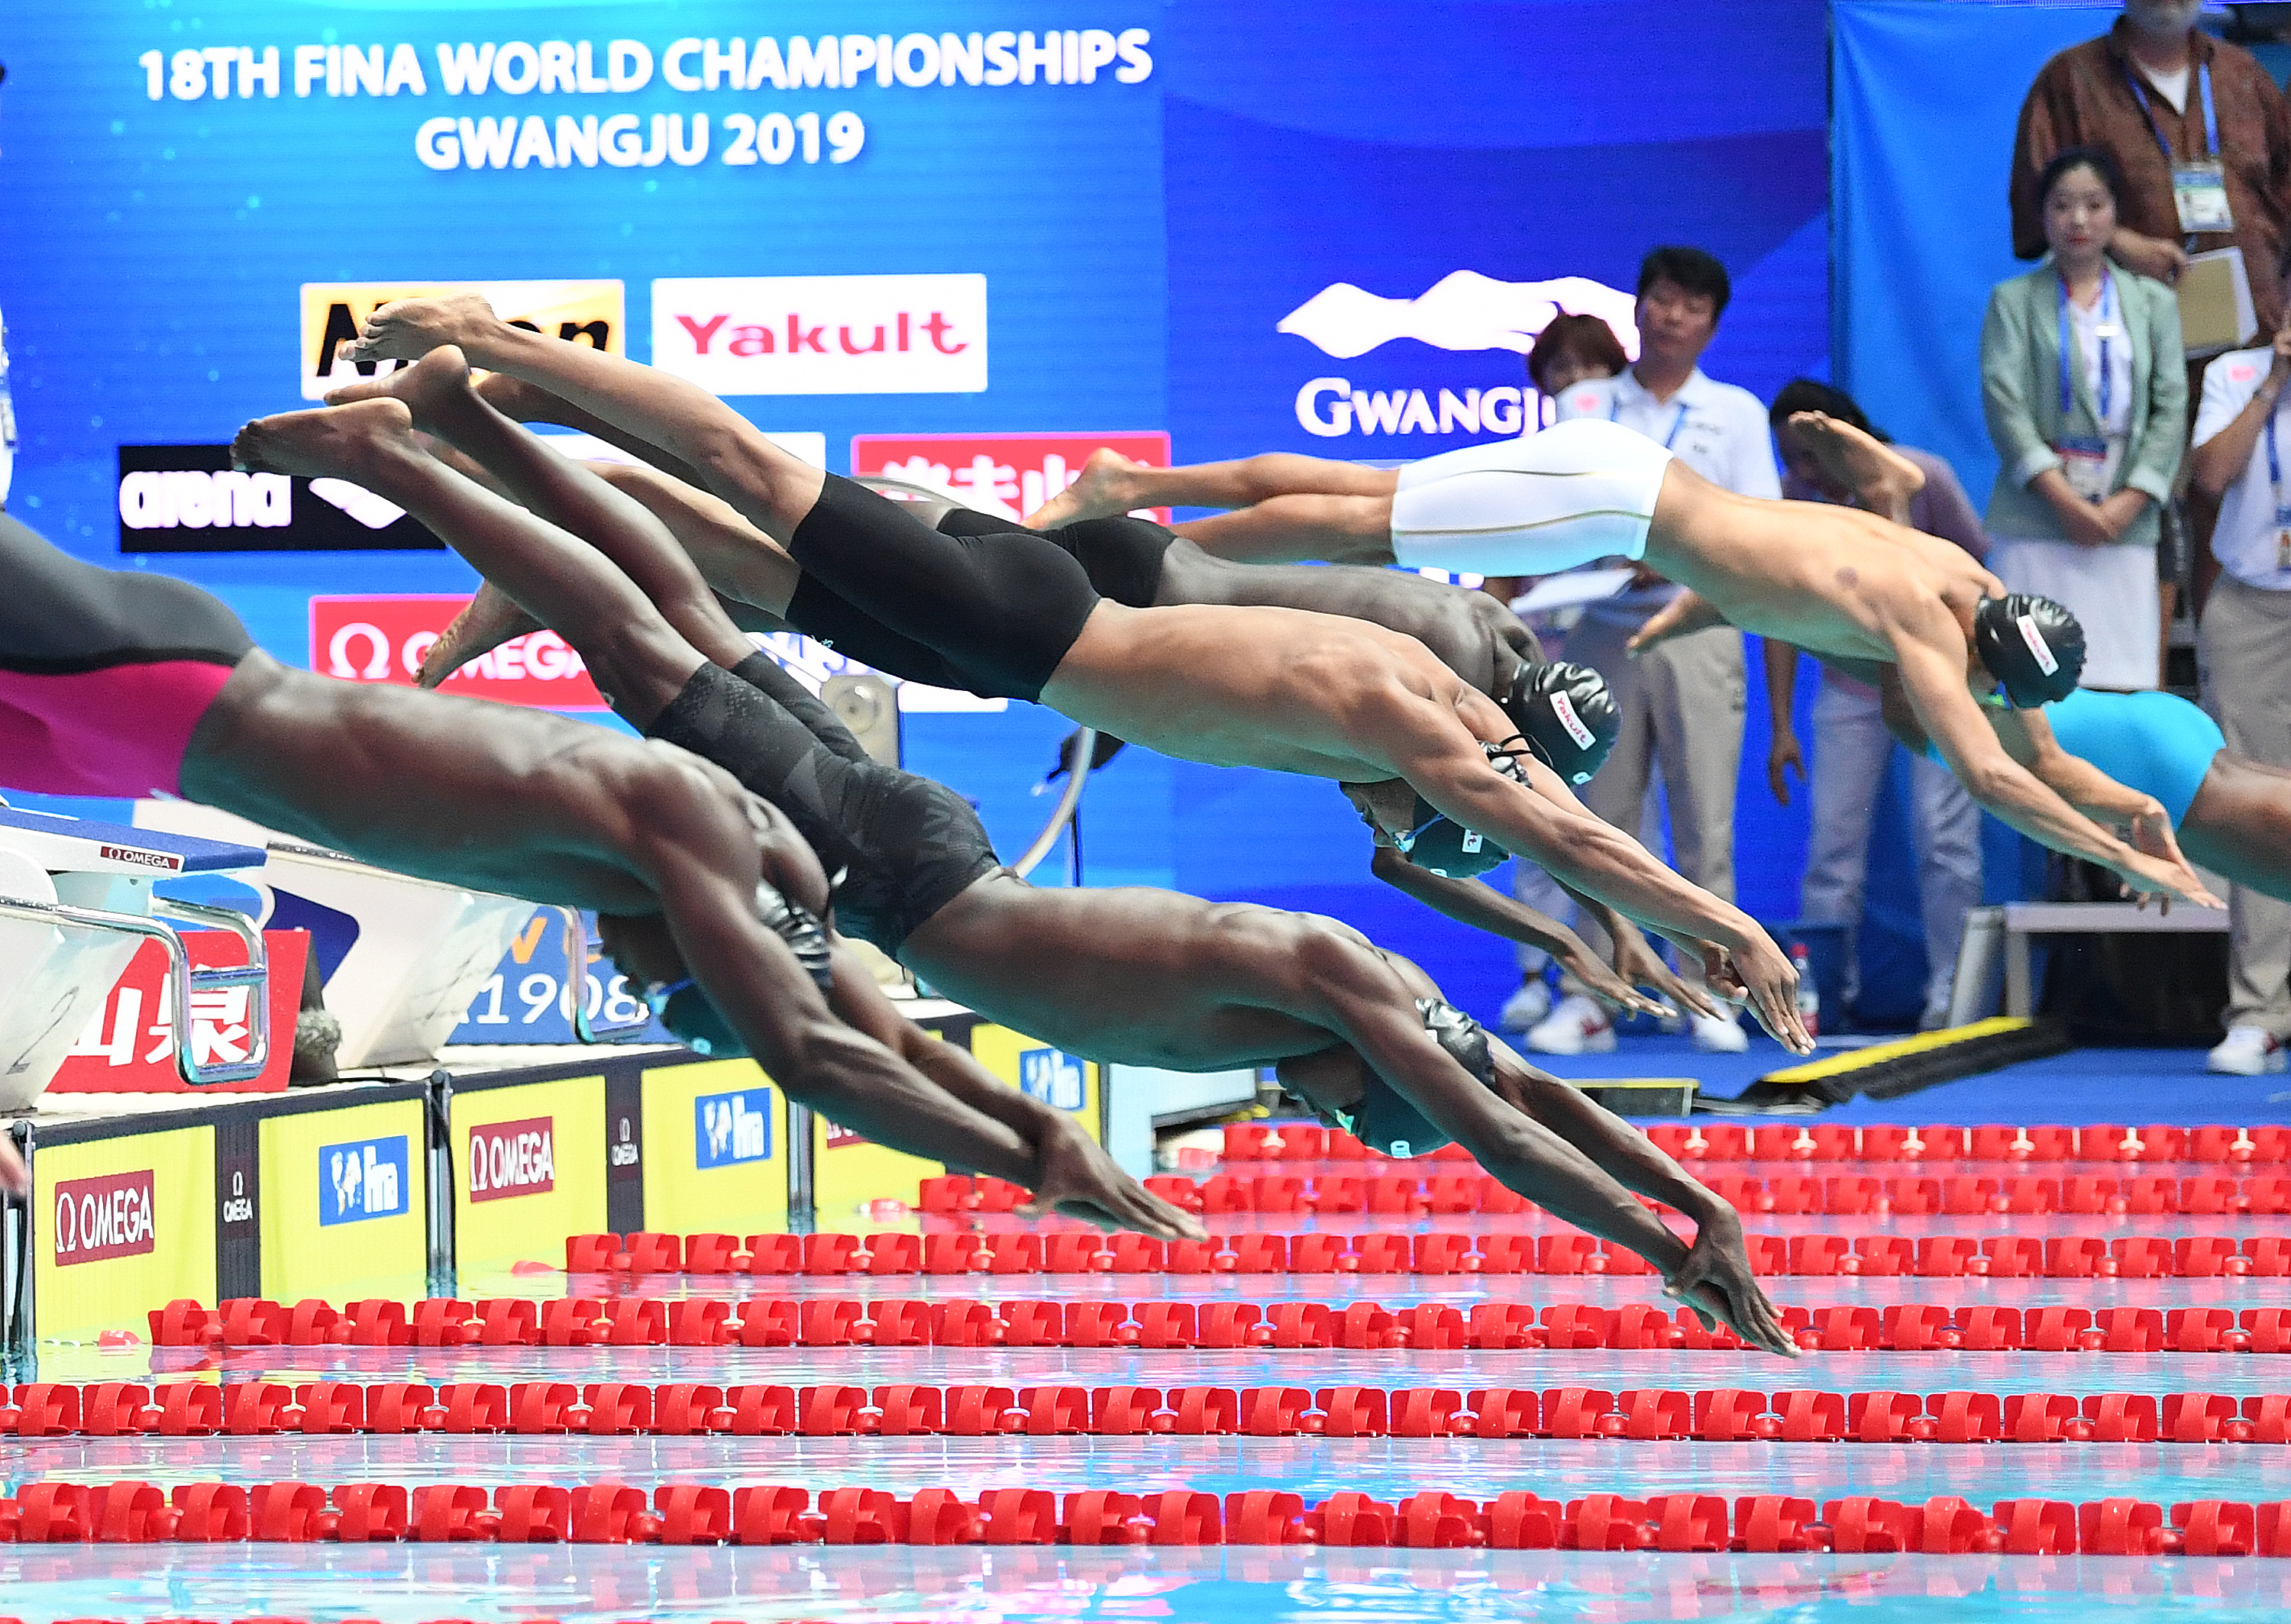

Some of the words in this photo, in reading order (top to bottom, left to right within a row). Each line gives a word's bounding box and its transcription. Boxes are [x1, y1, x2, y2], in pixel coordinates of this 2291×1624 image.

[138, 44, 280, 101] 18TH
[294, 43, 427, 97] FINA
[435, 39, 654, 96] WORLD
[661, 27, 1154, 92] CHAMPIONSHIPS
[415, 112, 709, 170] GWANGJU
[722, 110, 864, 166] 2019
[676, 311, 968, 358] Yakult
[119, 470, 292, 529] arena
[1556, 698, 1588, 744] Yakult
[123, 851, 170, 868] OMEGA
[490, 1130, 555, 1190] OMEGA
[80, 1185, 154, 1250] OMEGA
